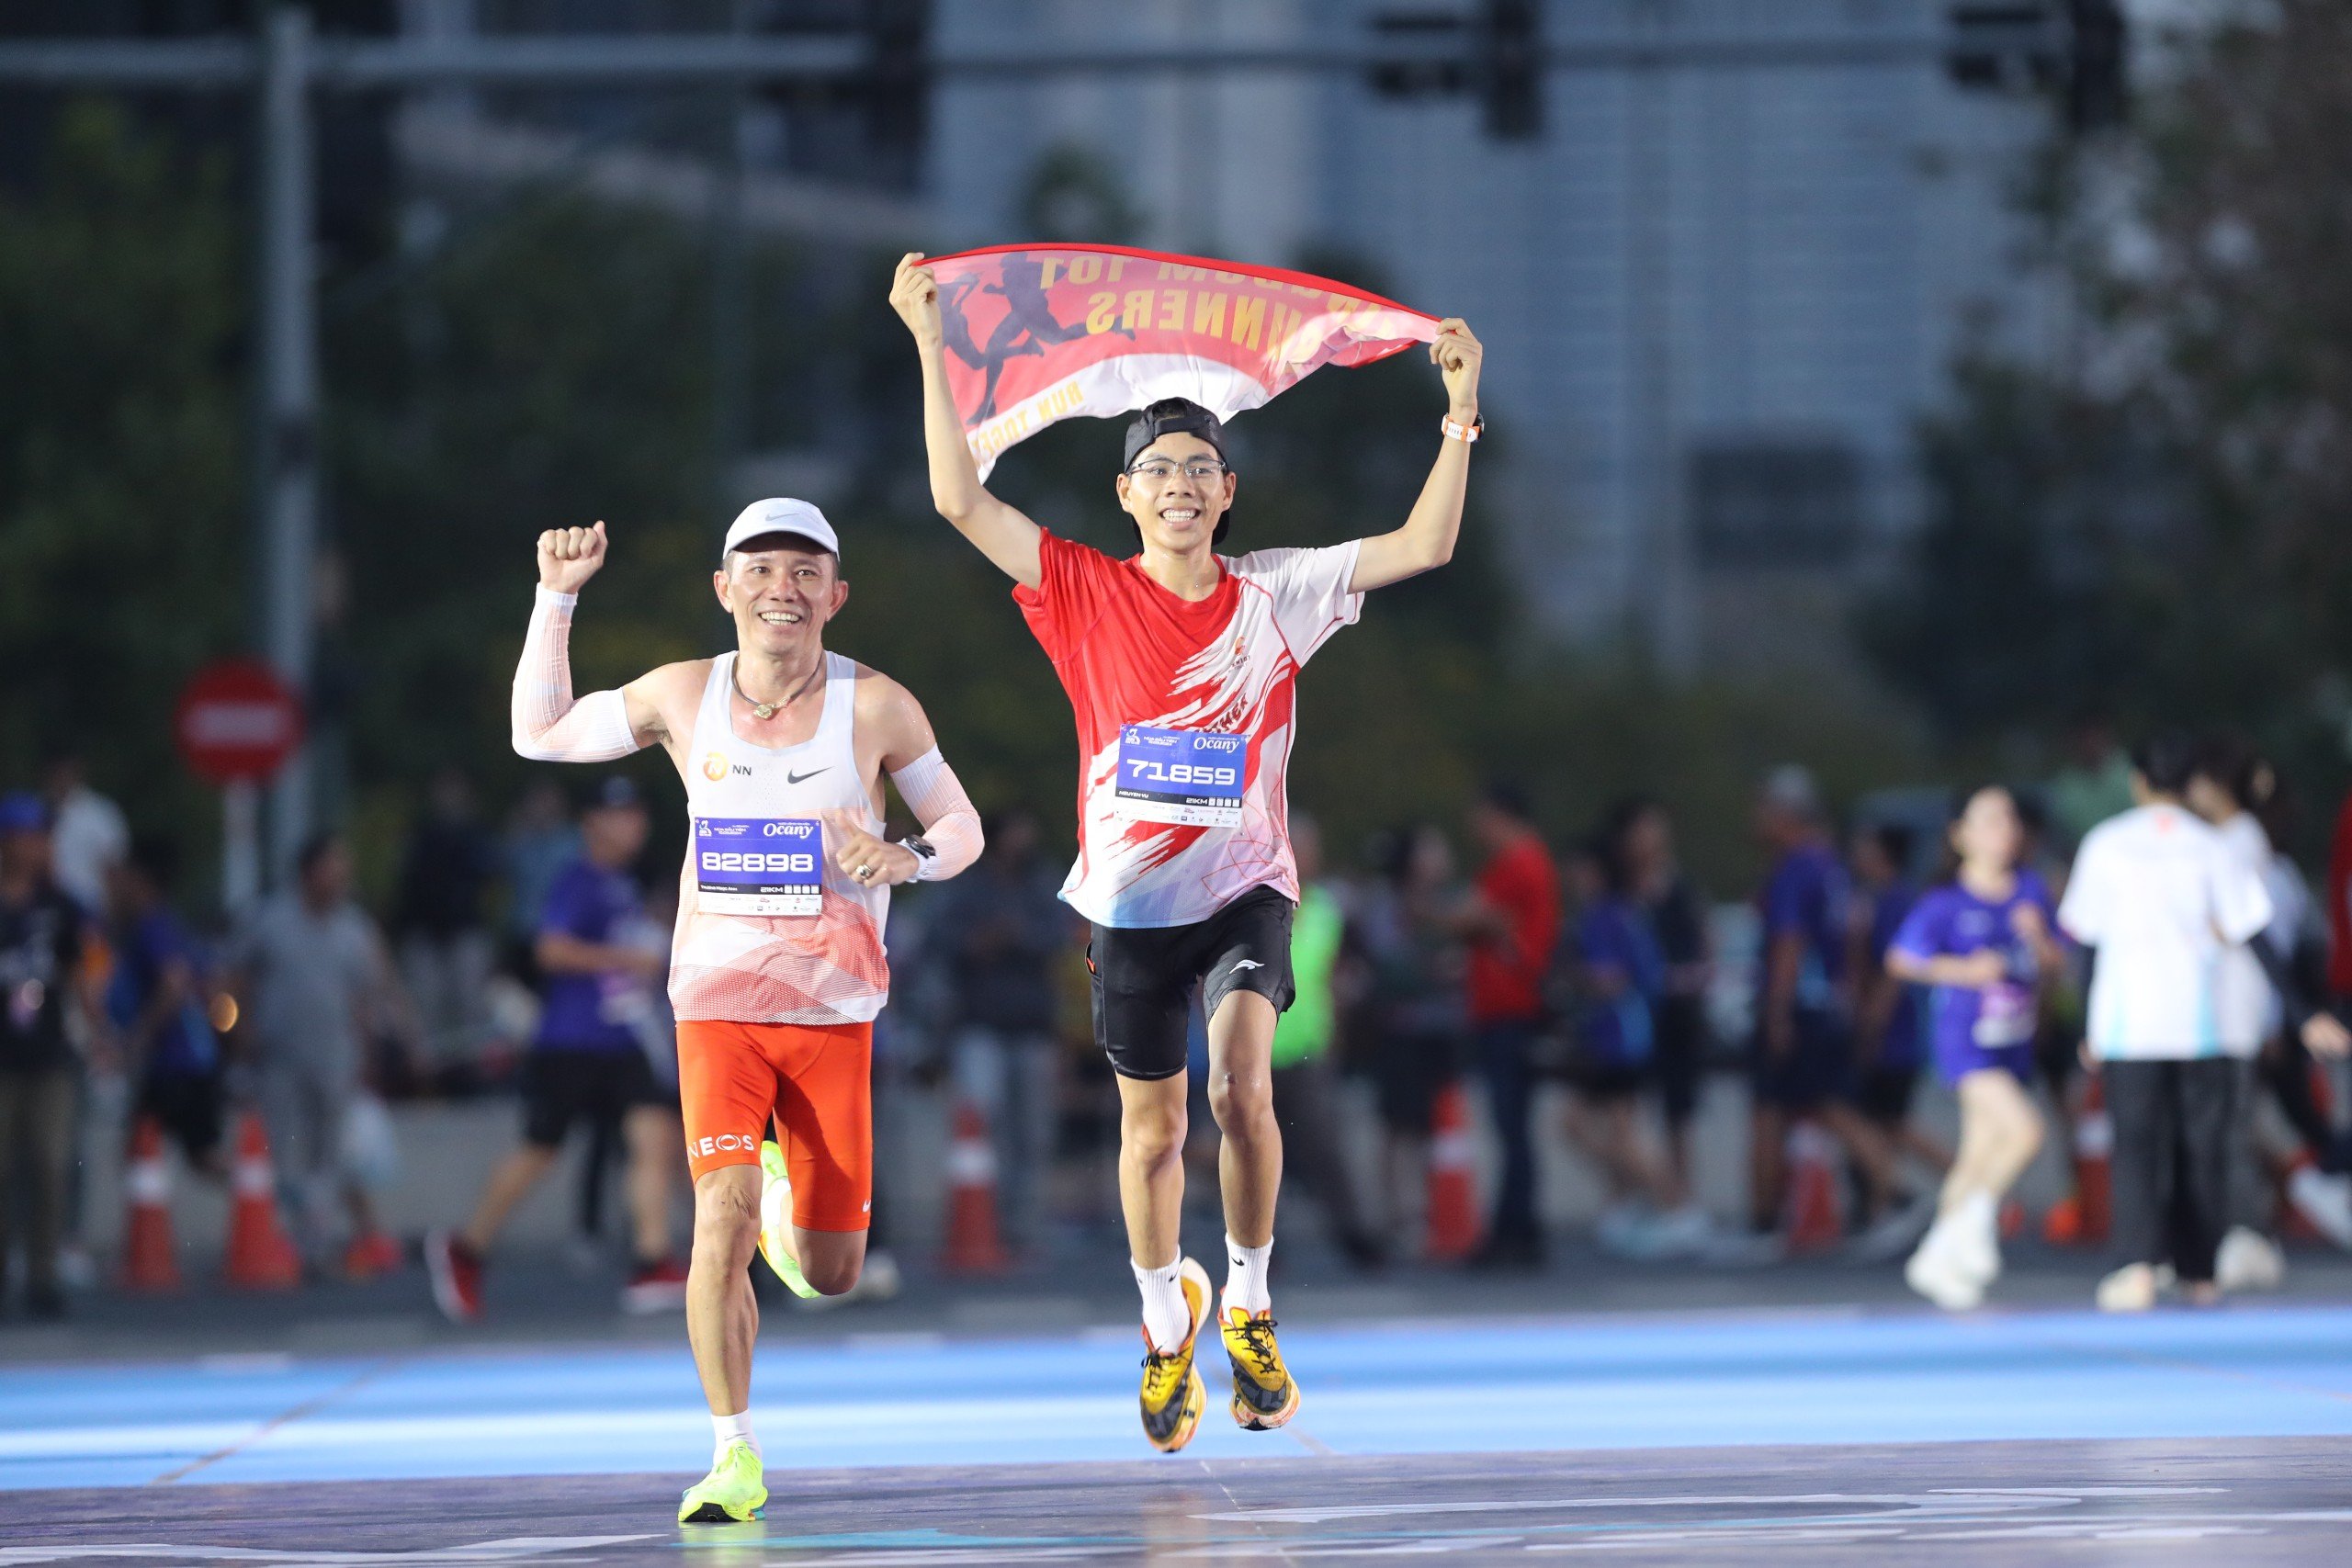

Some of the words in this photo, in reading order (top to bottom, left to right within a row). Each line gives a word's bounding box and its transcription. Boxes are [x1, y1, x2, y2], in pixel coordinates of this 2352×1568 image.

[1193, 737, 1239, 753] Ocany
[732, 764, 752, 776] NN
[1126, 758, 1236, 785] 71859
[763, 823, 814, 839] Ocany
[702, 852, 813, 872] 82898
